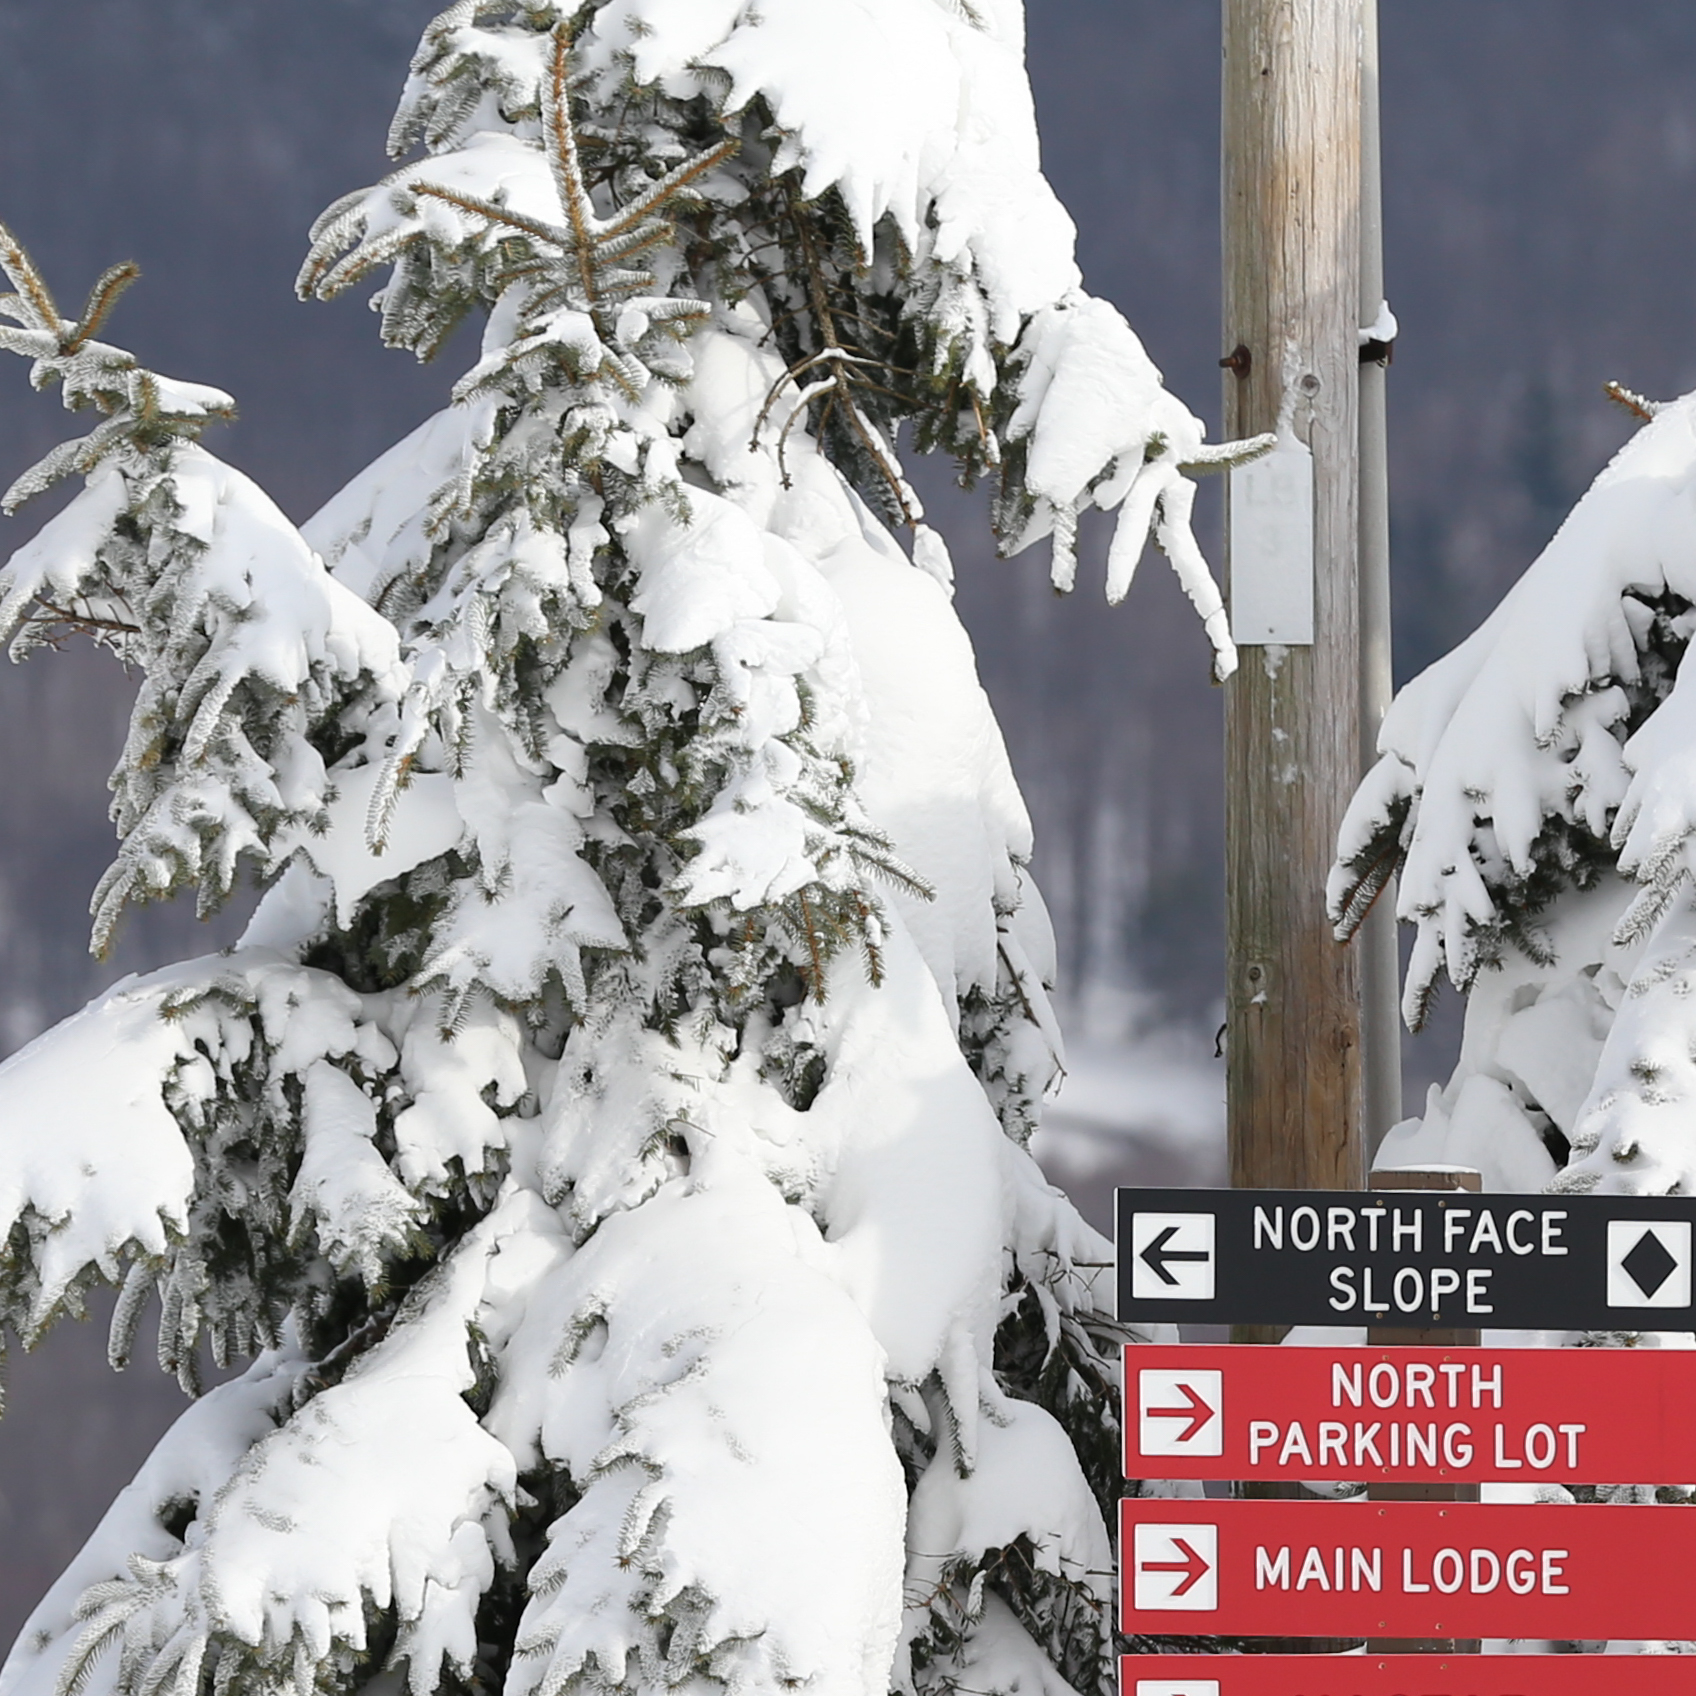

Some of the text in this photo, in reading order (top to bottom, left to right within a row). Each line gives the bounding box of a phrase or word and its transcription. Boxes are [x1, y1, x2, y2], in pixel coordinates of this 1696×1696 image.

[1254, 1206, 1568, 1255] NORTH FACE
[1329, 1266, 1493, 1314] SLOPE
[1332, 1362, 1502, 1408] NORTH
[1249, 1421, 1586, 1469] PARKING LOT
[1256, 1546, 1569, 1595] MAIN LODGE
